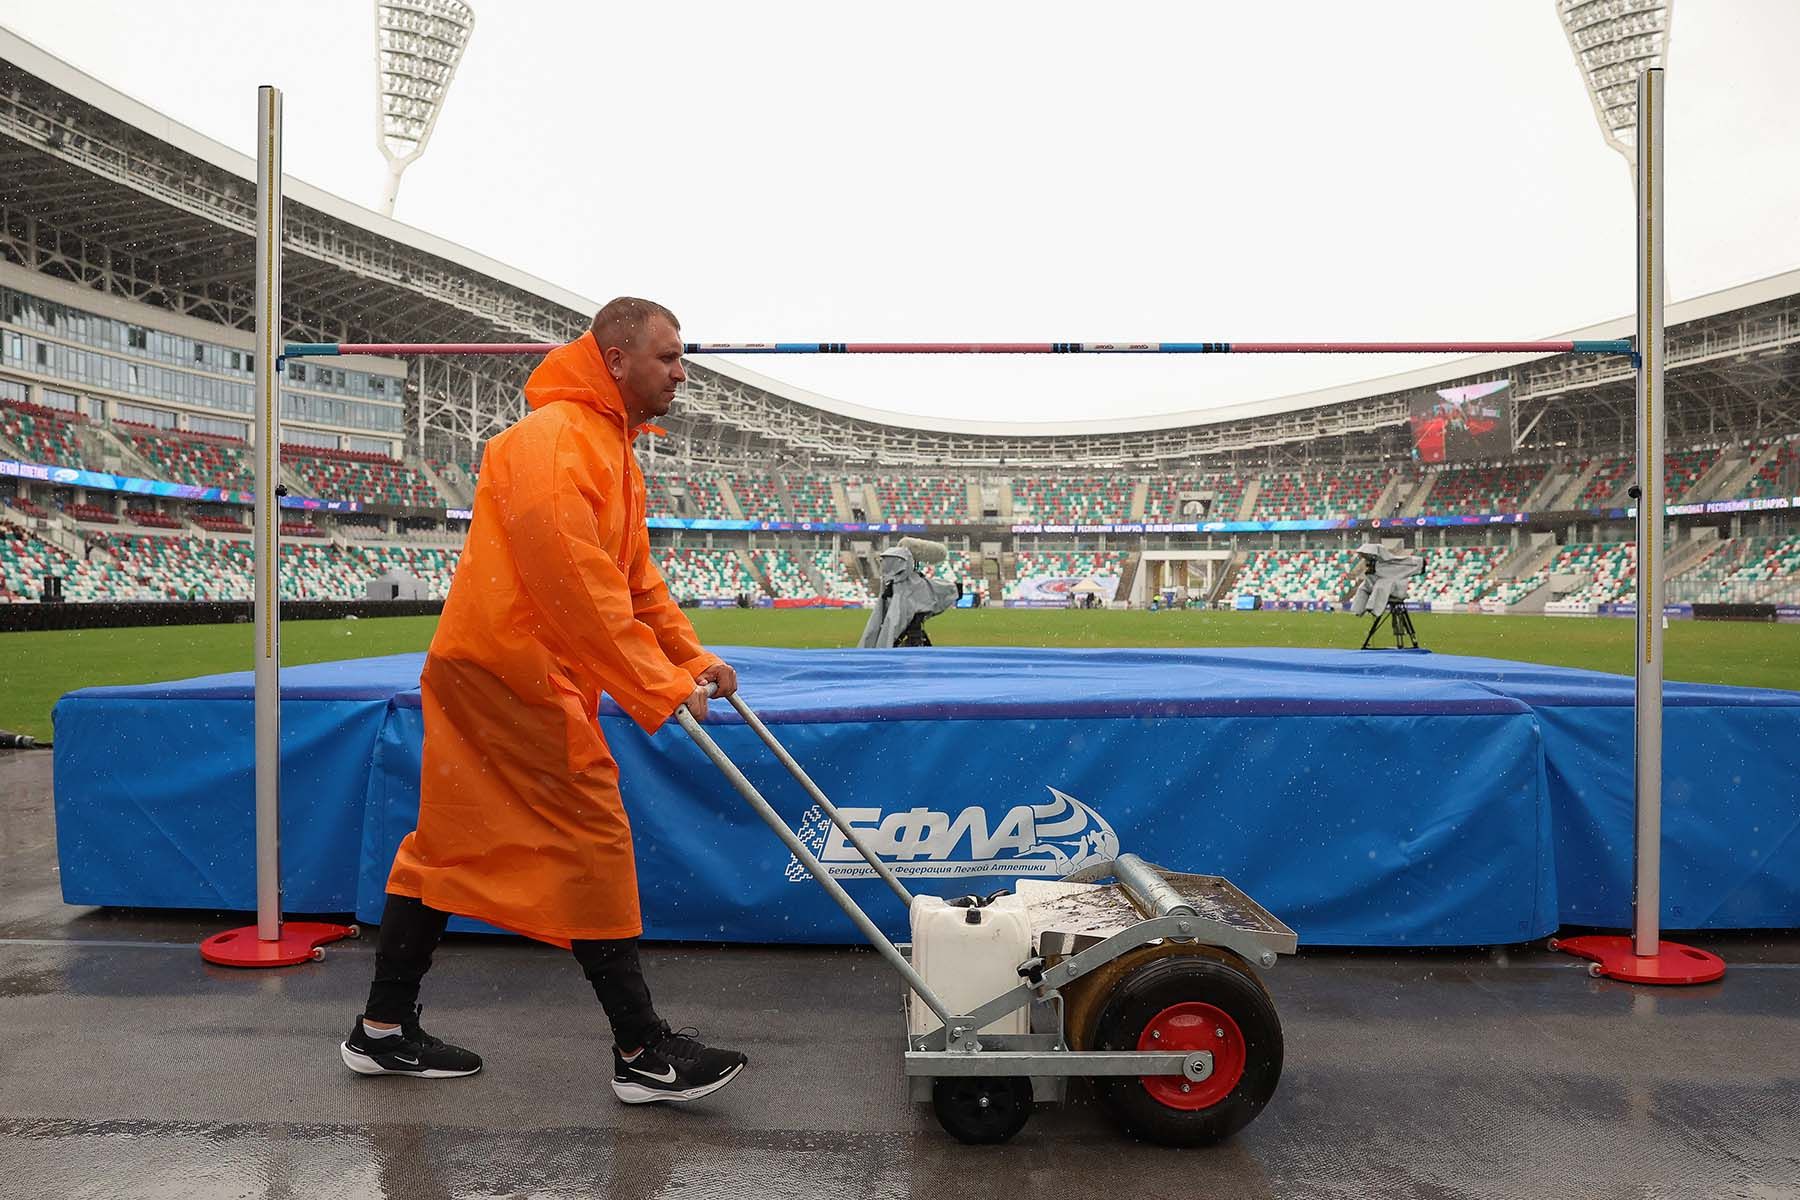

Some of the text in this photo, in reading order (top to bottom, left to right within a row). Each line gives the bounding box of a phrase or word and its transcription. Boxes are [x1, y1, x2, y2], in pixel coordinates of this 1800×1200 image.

[828, 863, 1046, 876] Белорусс Федерация Легкой Атлетики
